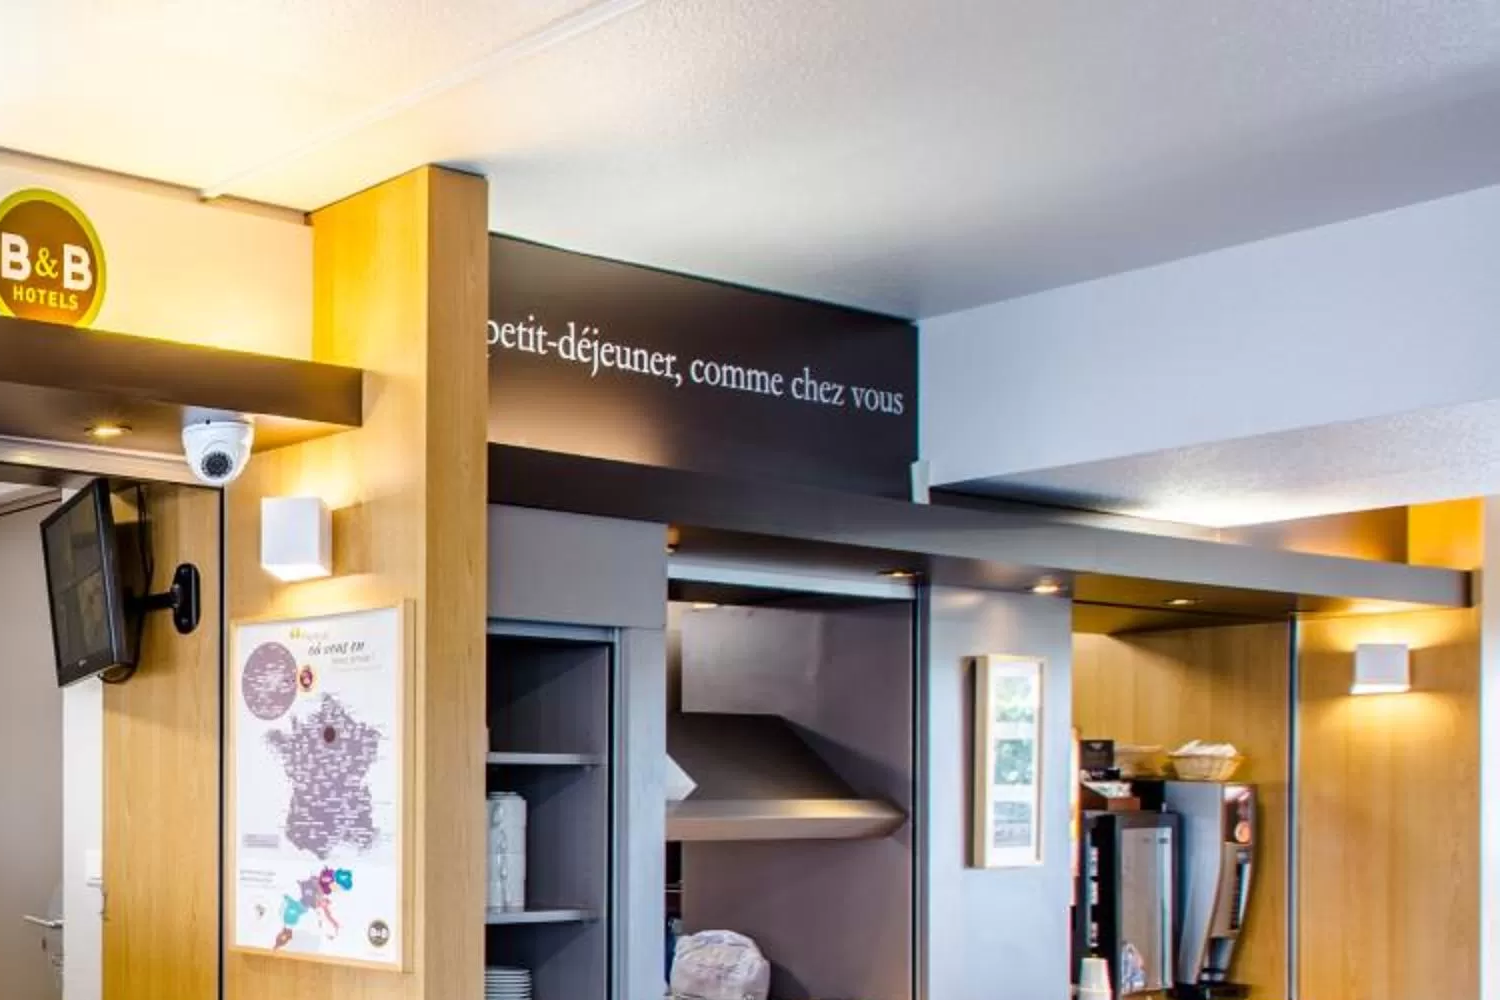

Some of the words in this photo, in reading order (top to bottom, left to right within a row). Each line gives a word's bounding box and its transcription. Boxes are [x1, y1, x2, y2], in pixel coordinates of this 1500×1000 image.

[1, 231, 93, 291] B&B
[13, 284, 79, 311] HOTELS
[690, 359, 784, 396] comme
[791, 367, 845, 406] chez
[851, 386, 904, 415] vous
